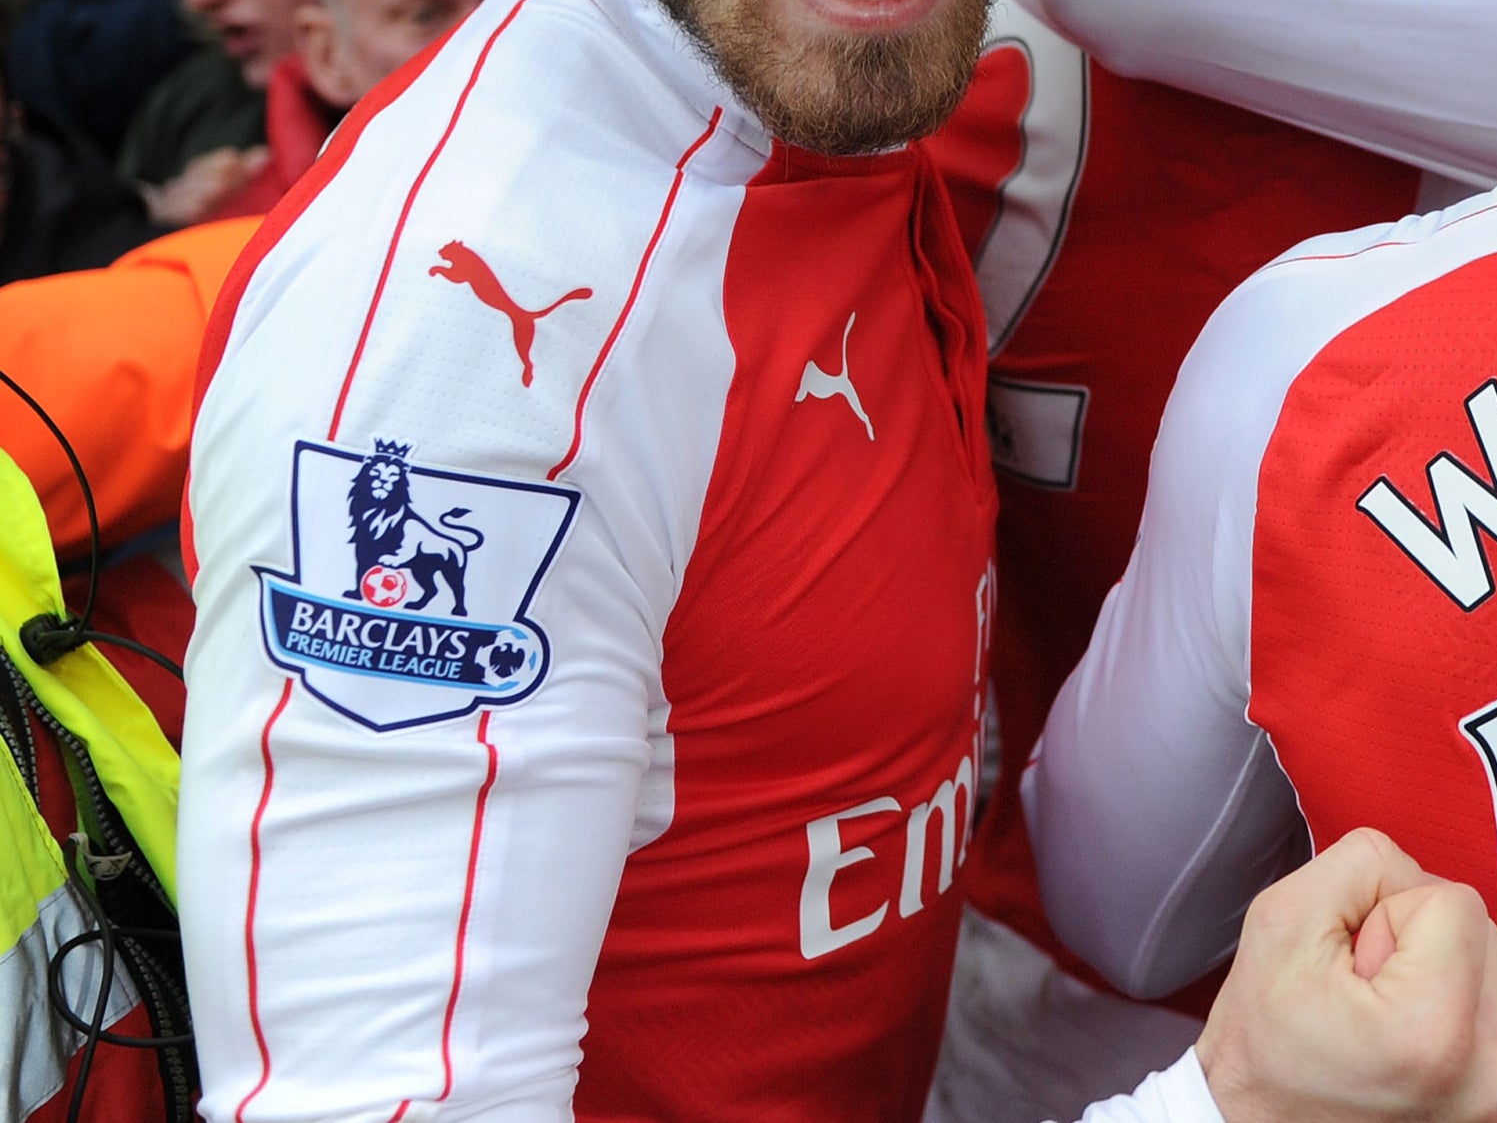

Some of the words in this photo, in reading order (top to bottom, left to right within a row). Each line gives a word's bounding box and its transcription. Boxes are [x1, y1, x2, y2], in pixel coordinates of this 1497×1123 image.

[285, 631, 373, 668] PREMIER
[378, 652, 463, 679] LEAGUE
[290, 601, 470, 660] BARCLAYS
